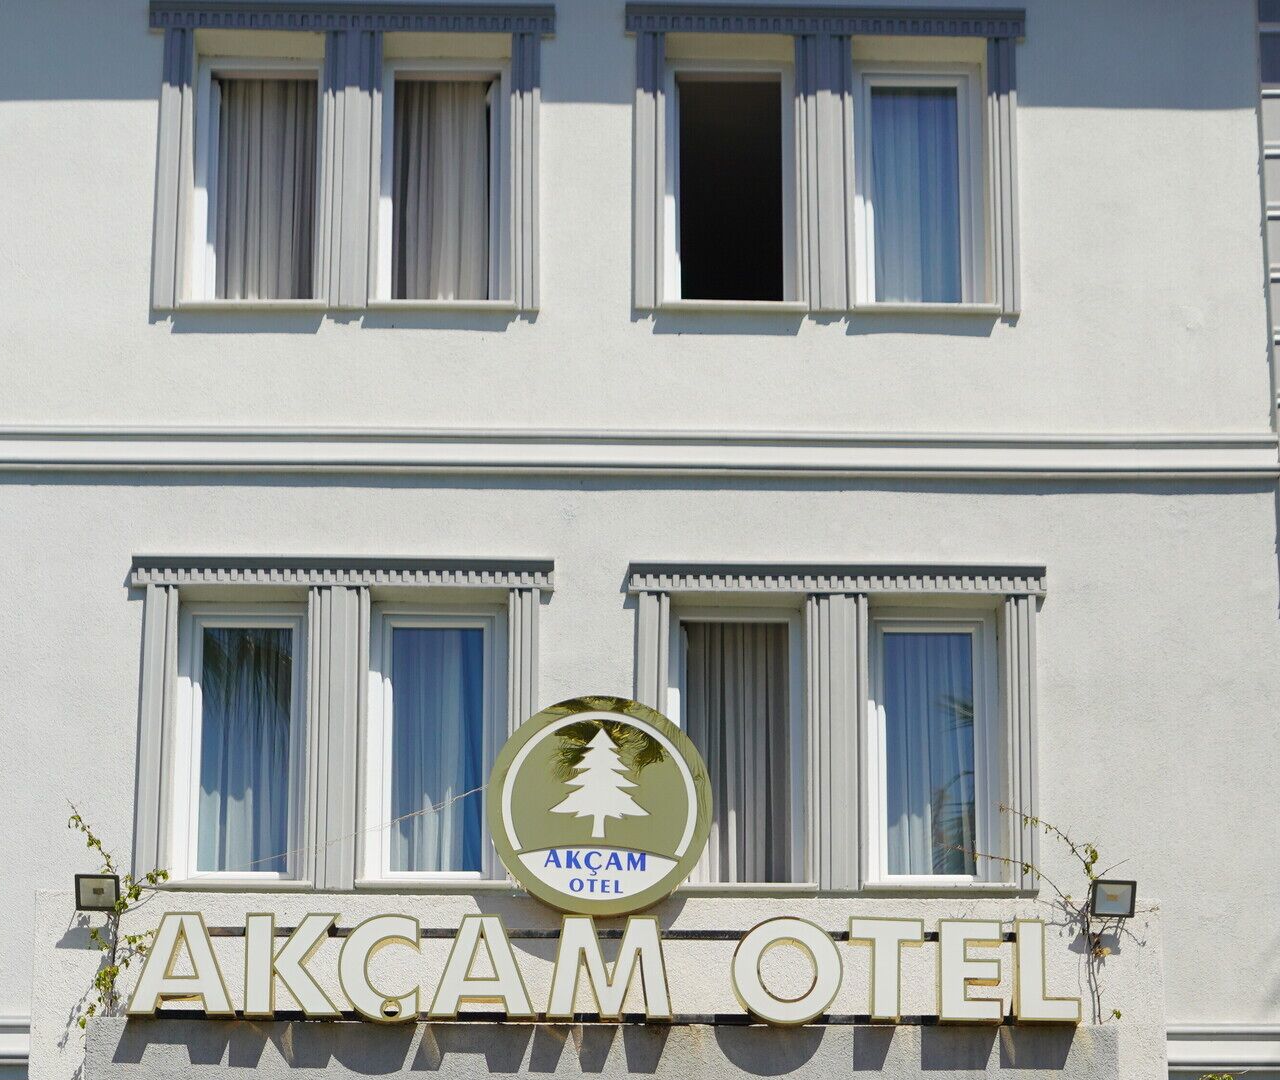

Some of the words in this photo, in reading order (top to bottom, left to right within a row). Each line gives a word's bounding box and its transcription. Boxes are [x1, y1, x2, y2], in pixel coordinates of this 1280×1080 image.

[543, 849, 647, 876] AKÇAM
[569, 878, 624, 894] OTEL
[126, 911, 673, 1023] AKÇAM
[731, 915, 1082, 1026] OTEL
